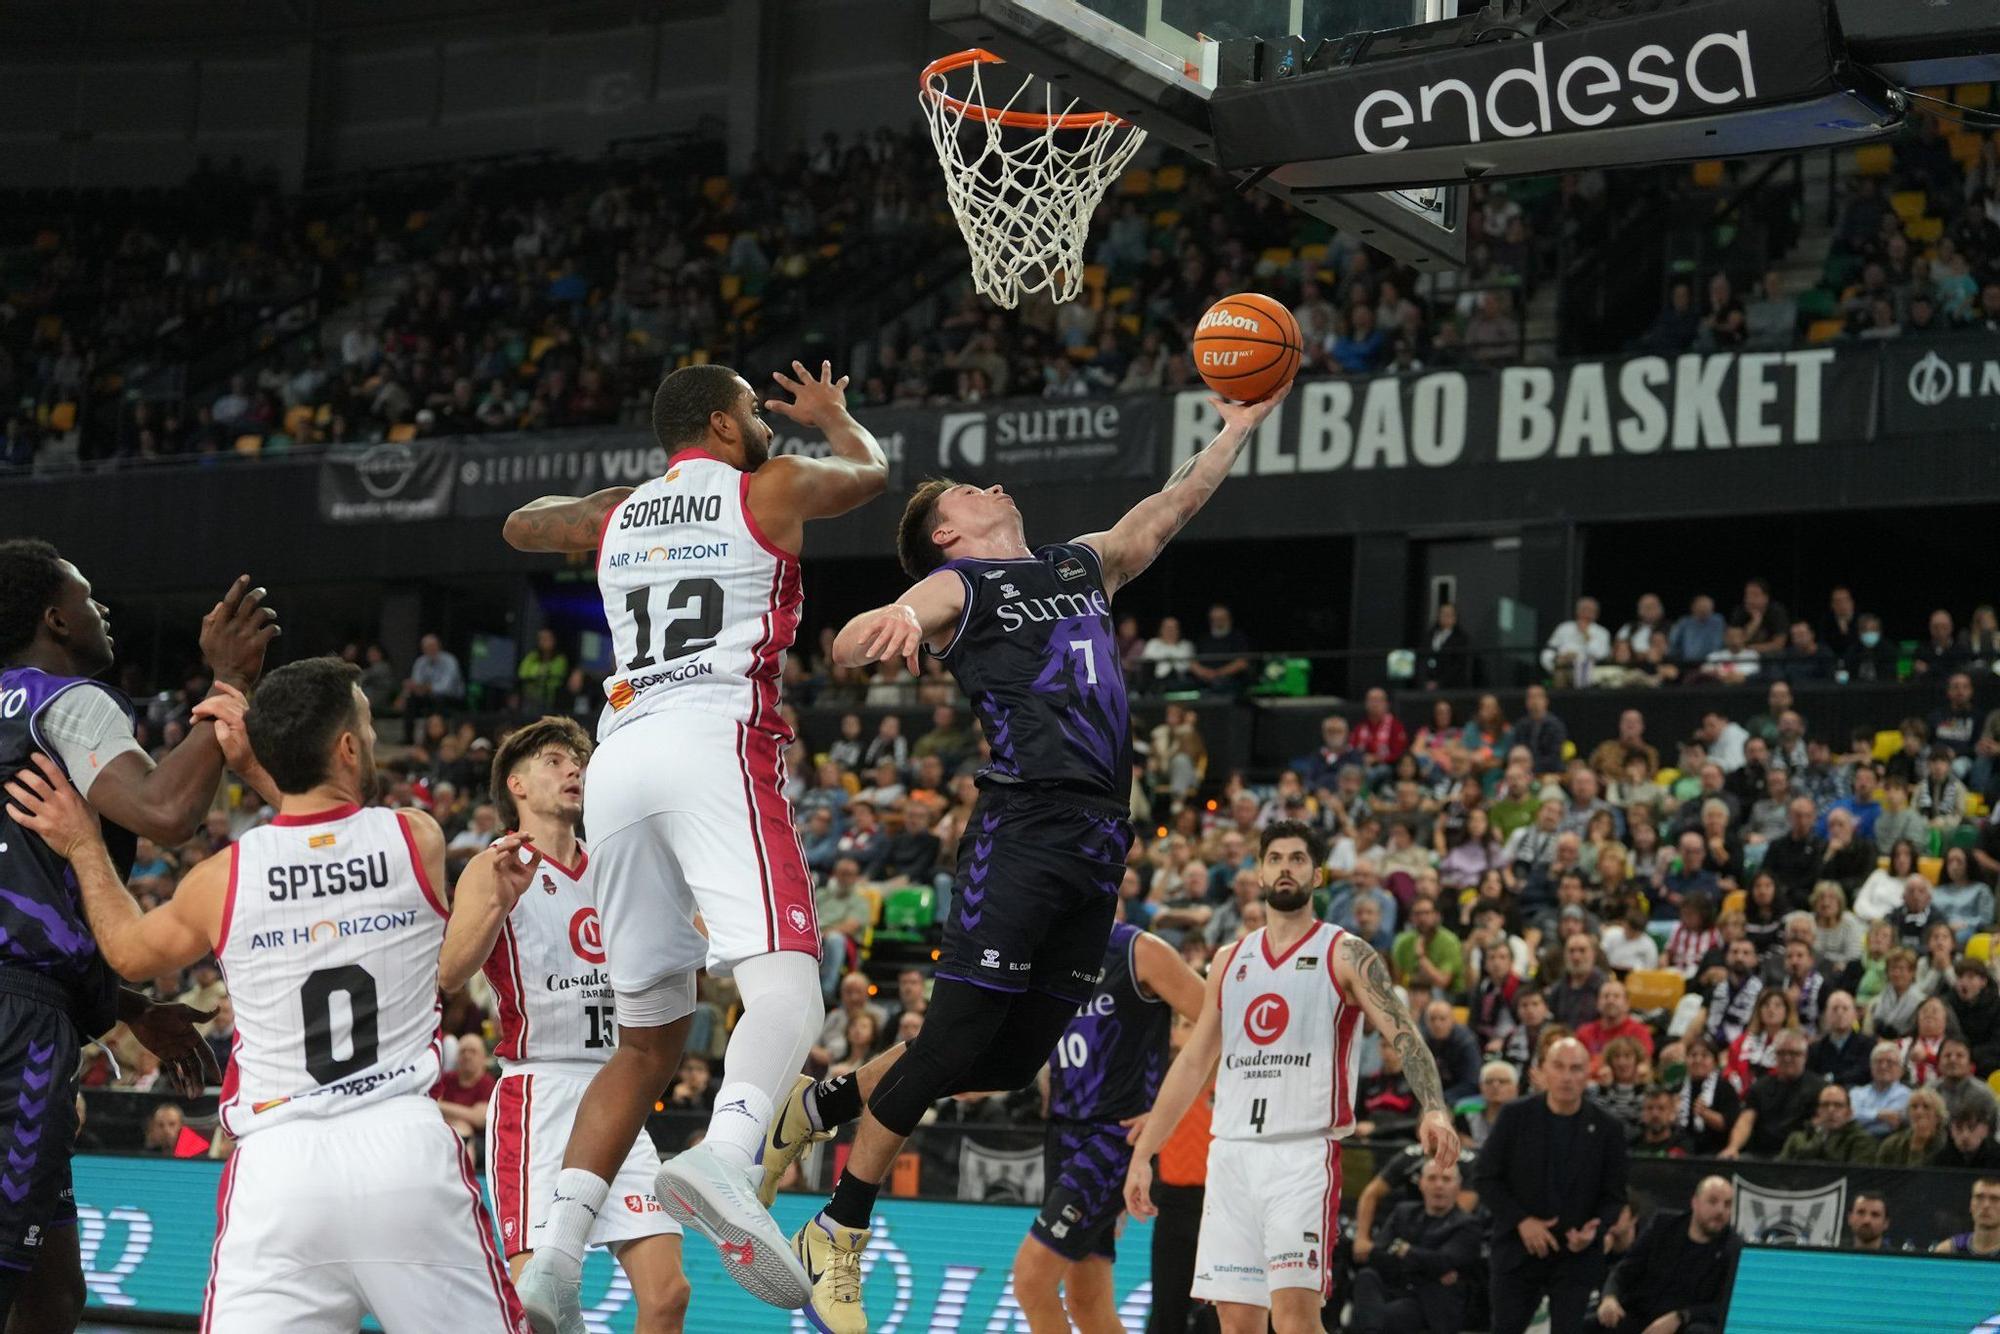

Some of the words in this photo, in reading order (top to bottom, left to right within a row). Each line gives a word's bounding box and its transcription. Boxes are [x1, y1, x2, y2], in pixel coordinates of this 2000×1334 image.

[1354, 30, 1757, 154] endesa
[1198, 309, 1259, 333] Wilson
[996, 404, 1120, 444] surne
[1496, 348, 1836, 462] BASKET
[601, 446, 668, 480] vue
[619, 495, 721, 529] SORIANO
[609, 552, 630, 568] AIR
[634, 543, 729, 564] HORIZONT
[625, 578, 725, 671] 12
[996, 590, 1110, 632] surne
[1069, 639, 1097, 684] 7
[268, 852, 389, 901] SPISSU
[251, 931, 285, 950] AIR
[293, 910, 418, 943] HORIZONT
[547, 968, 608, 992] Casade
[1071, 970, 1097, 983] NISS
[301, 964, 379, 1086] 0
[585, 1006, 615, 1048] 15
[1057, 1033, 1088, 1069] 10
[1226, 1050, 1312, 1071] Casademont
[1250, 1098, 1267, 1134] 4
